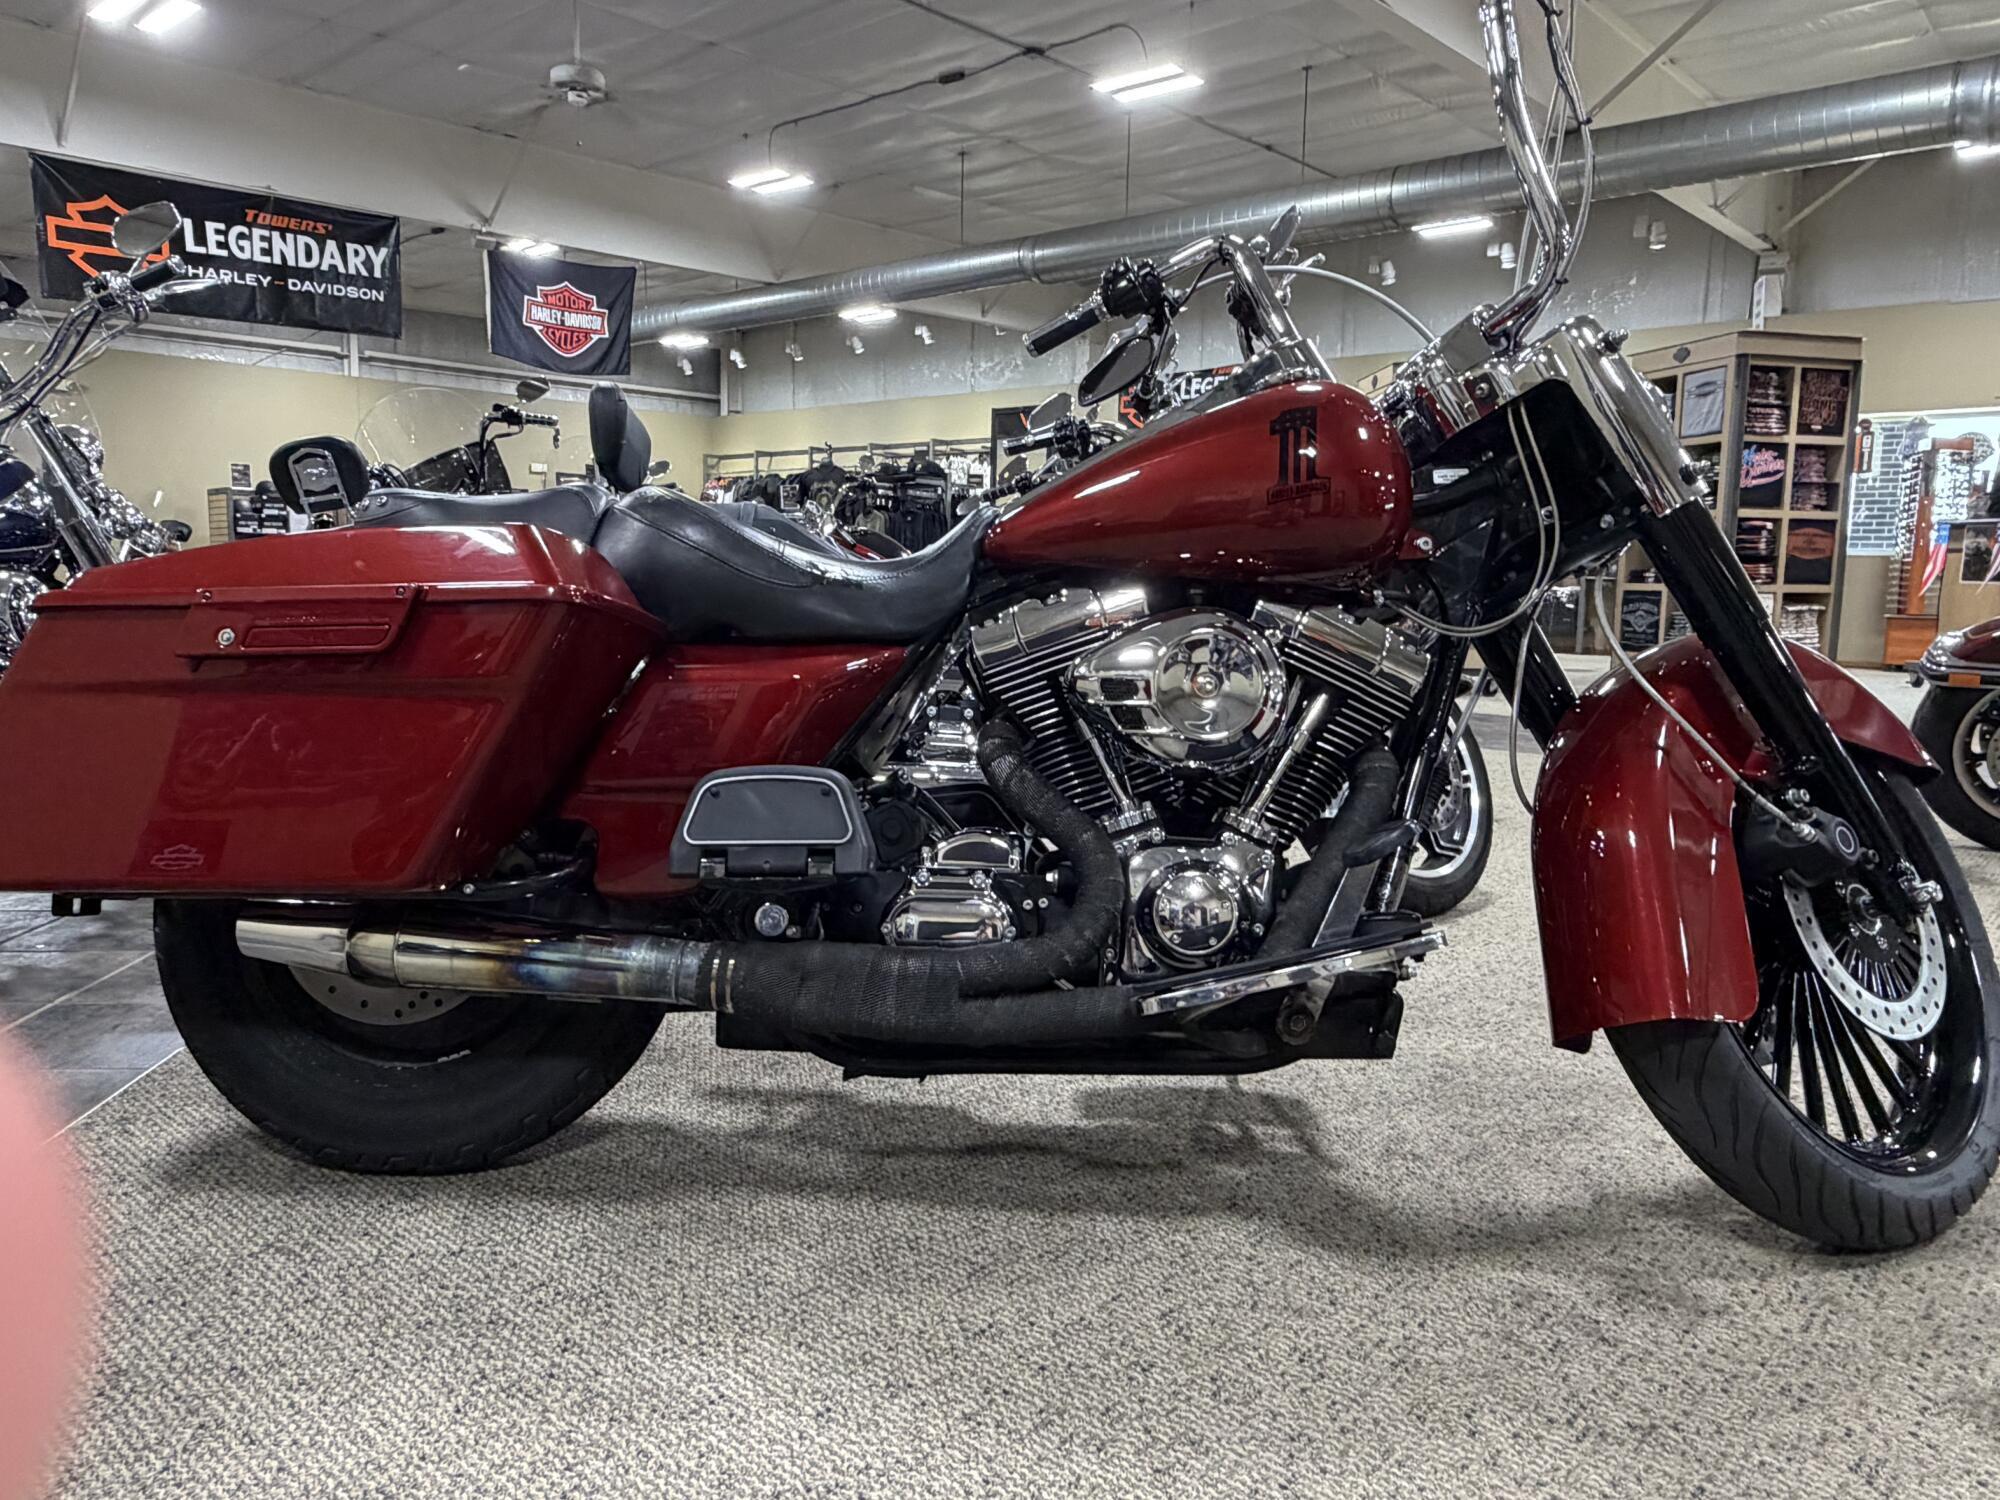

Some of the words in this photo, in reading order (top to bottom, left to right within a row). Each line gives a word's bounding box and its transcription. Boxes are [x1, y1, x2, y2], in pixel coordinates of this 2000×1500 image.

[245, 209, 333, 234] TOWERS'
[182, 217, 389, 278] LEGENDARY
[547, 291, 587, 311] MOTOR
[530, 304, 603, 331] HARLEY-DAVIDSON
[547, 328, 587, 350] CYCLES
